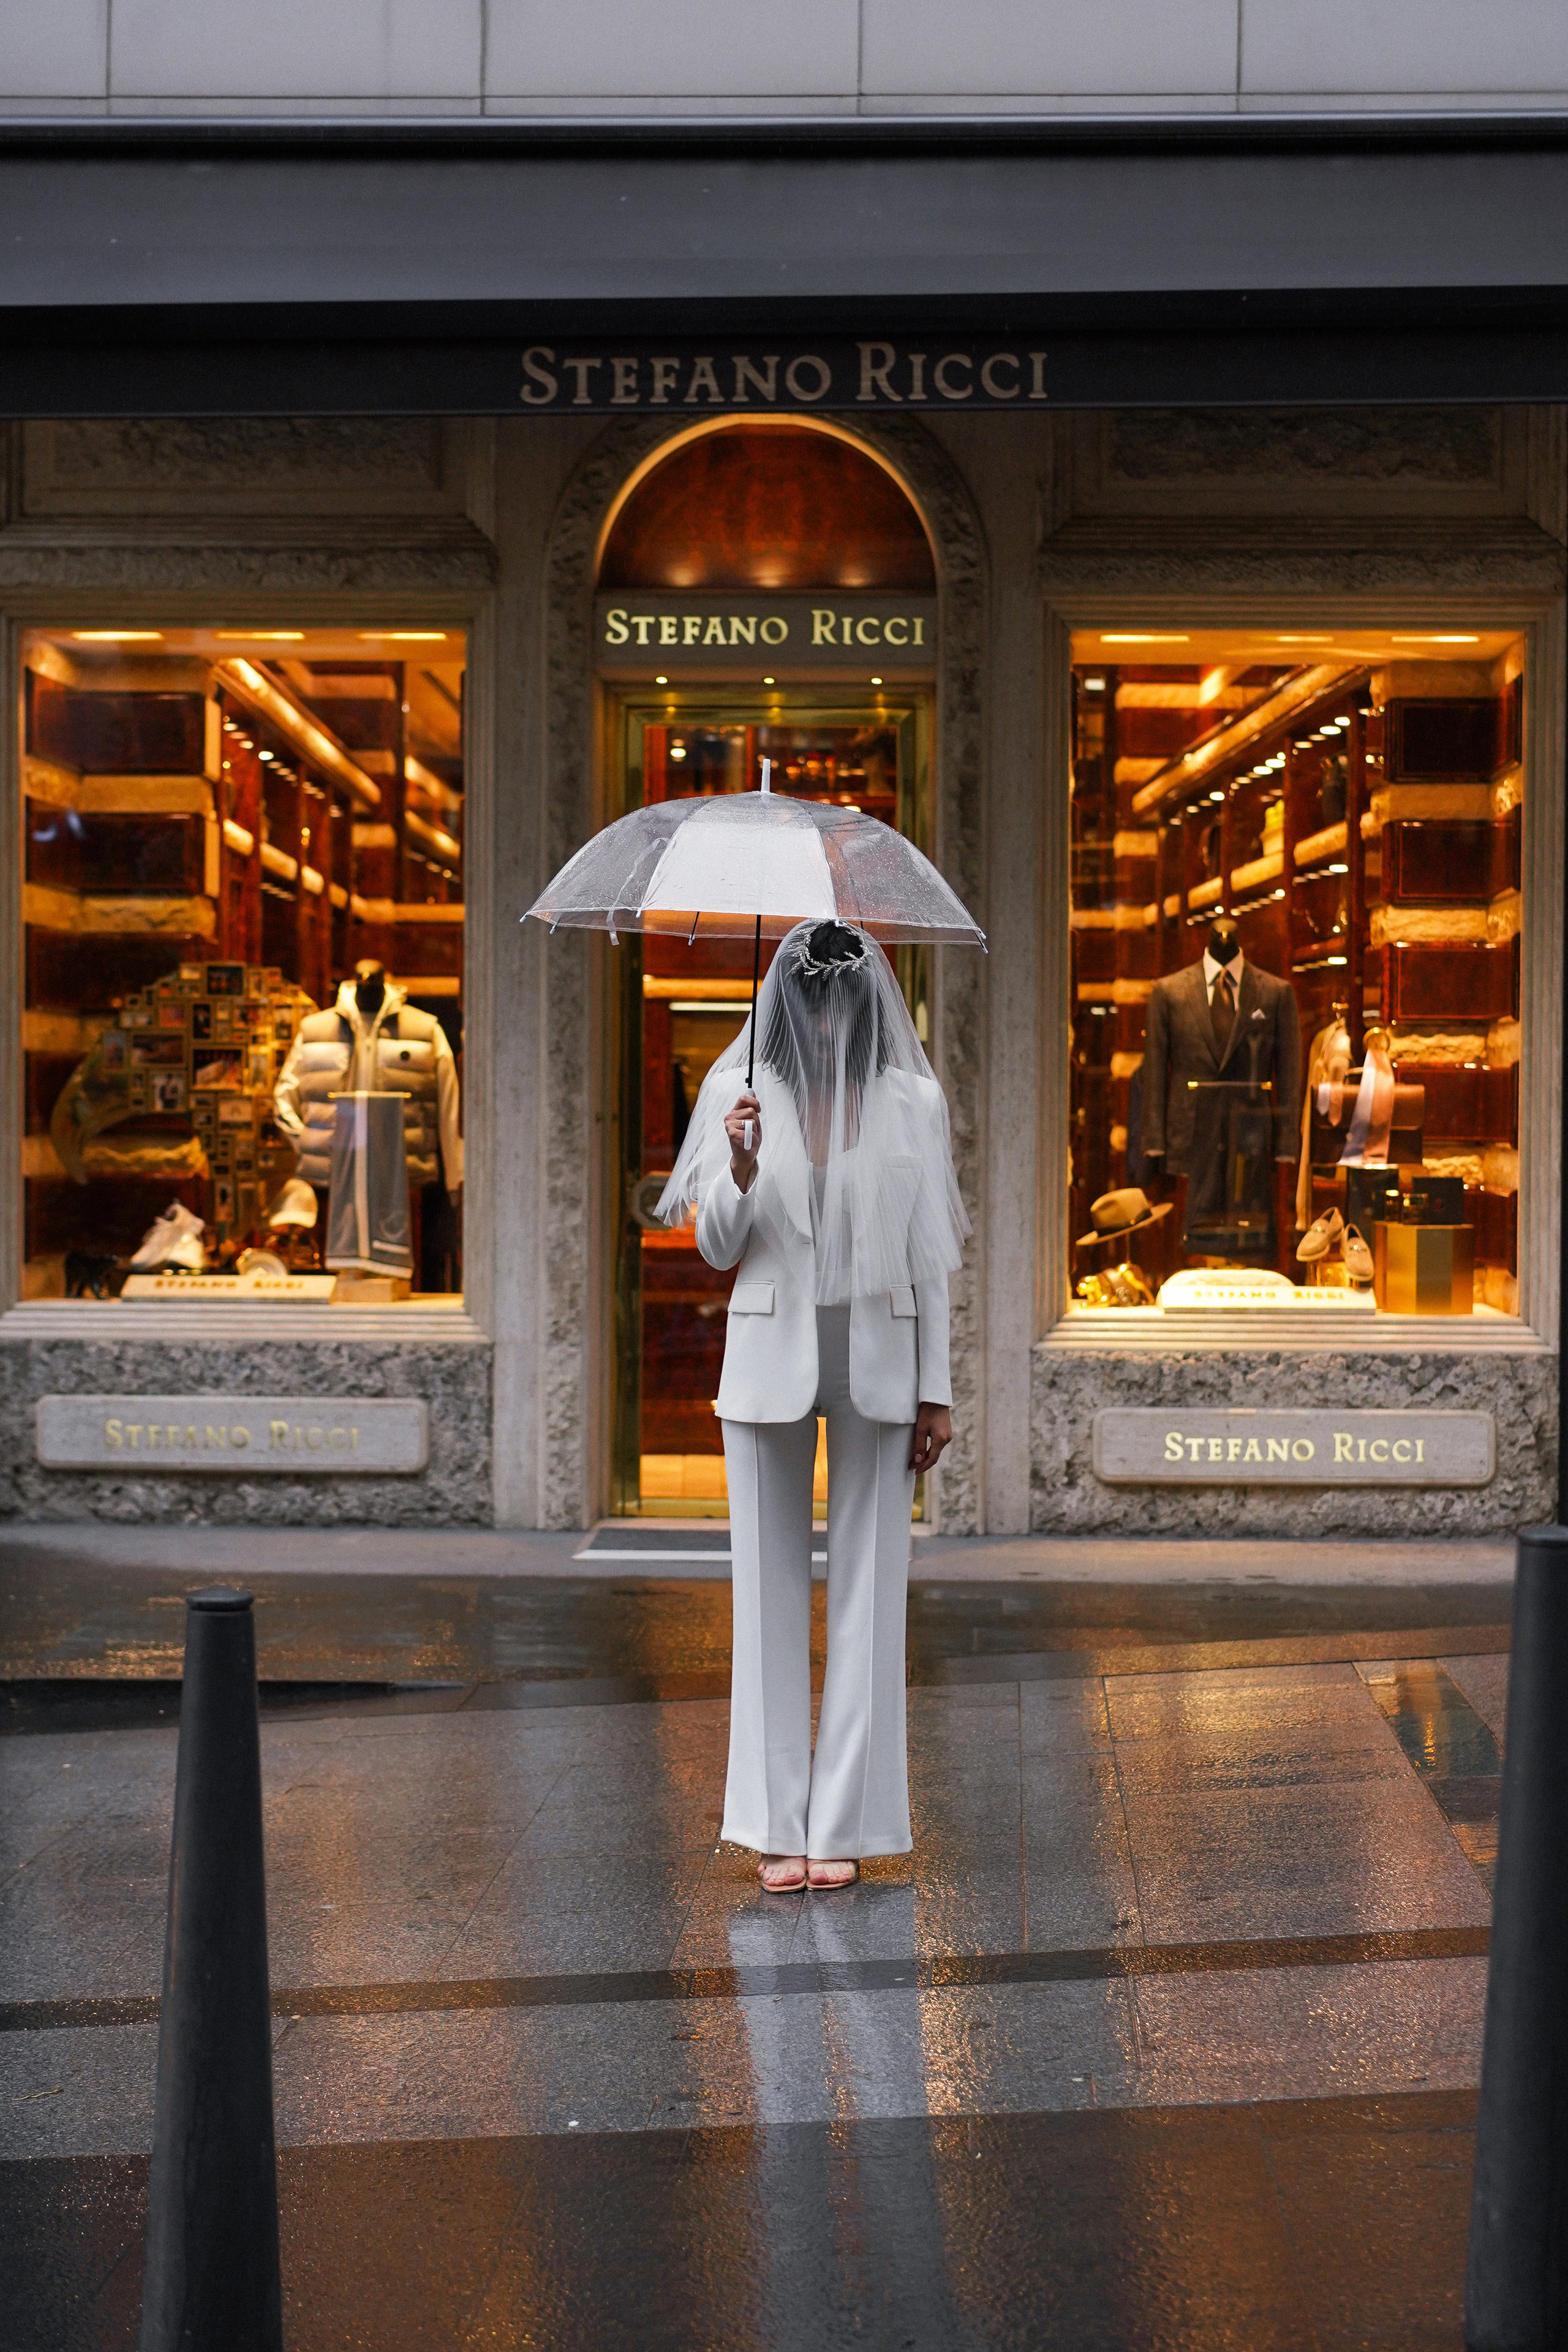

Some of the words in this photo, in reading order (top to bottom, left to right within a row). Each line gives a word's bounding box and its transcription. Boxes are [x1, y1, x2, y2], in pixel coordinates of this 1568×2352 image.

[521, 347, 831, 404] STEFANO
[856, 342, 1048, 401] RICCI
[605, 609, 788, 645] STEFANO
[811, 609, 924, 645] RICCI
[105, 1419, 251, 1450] STEFANO
[270, 1420, 360, 1451] RICCI
[1165, 1431, 1315, 1461] STEFANO
[1333, 1432, 1425, 1463] RICCI
